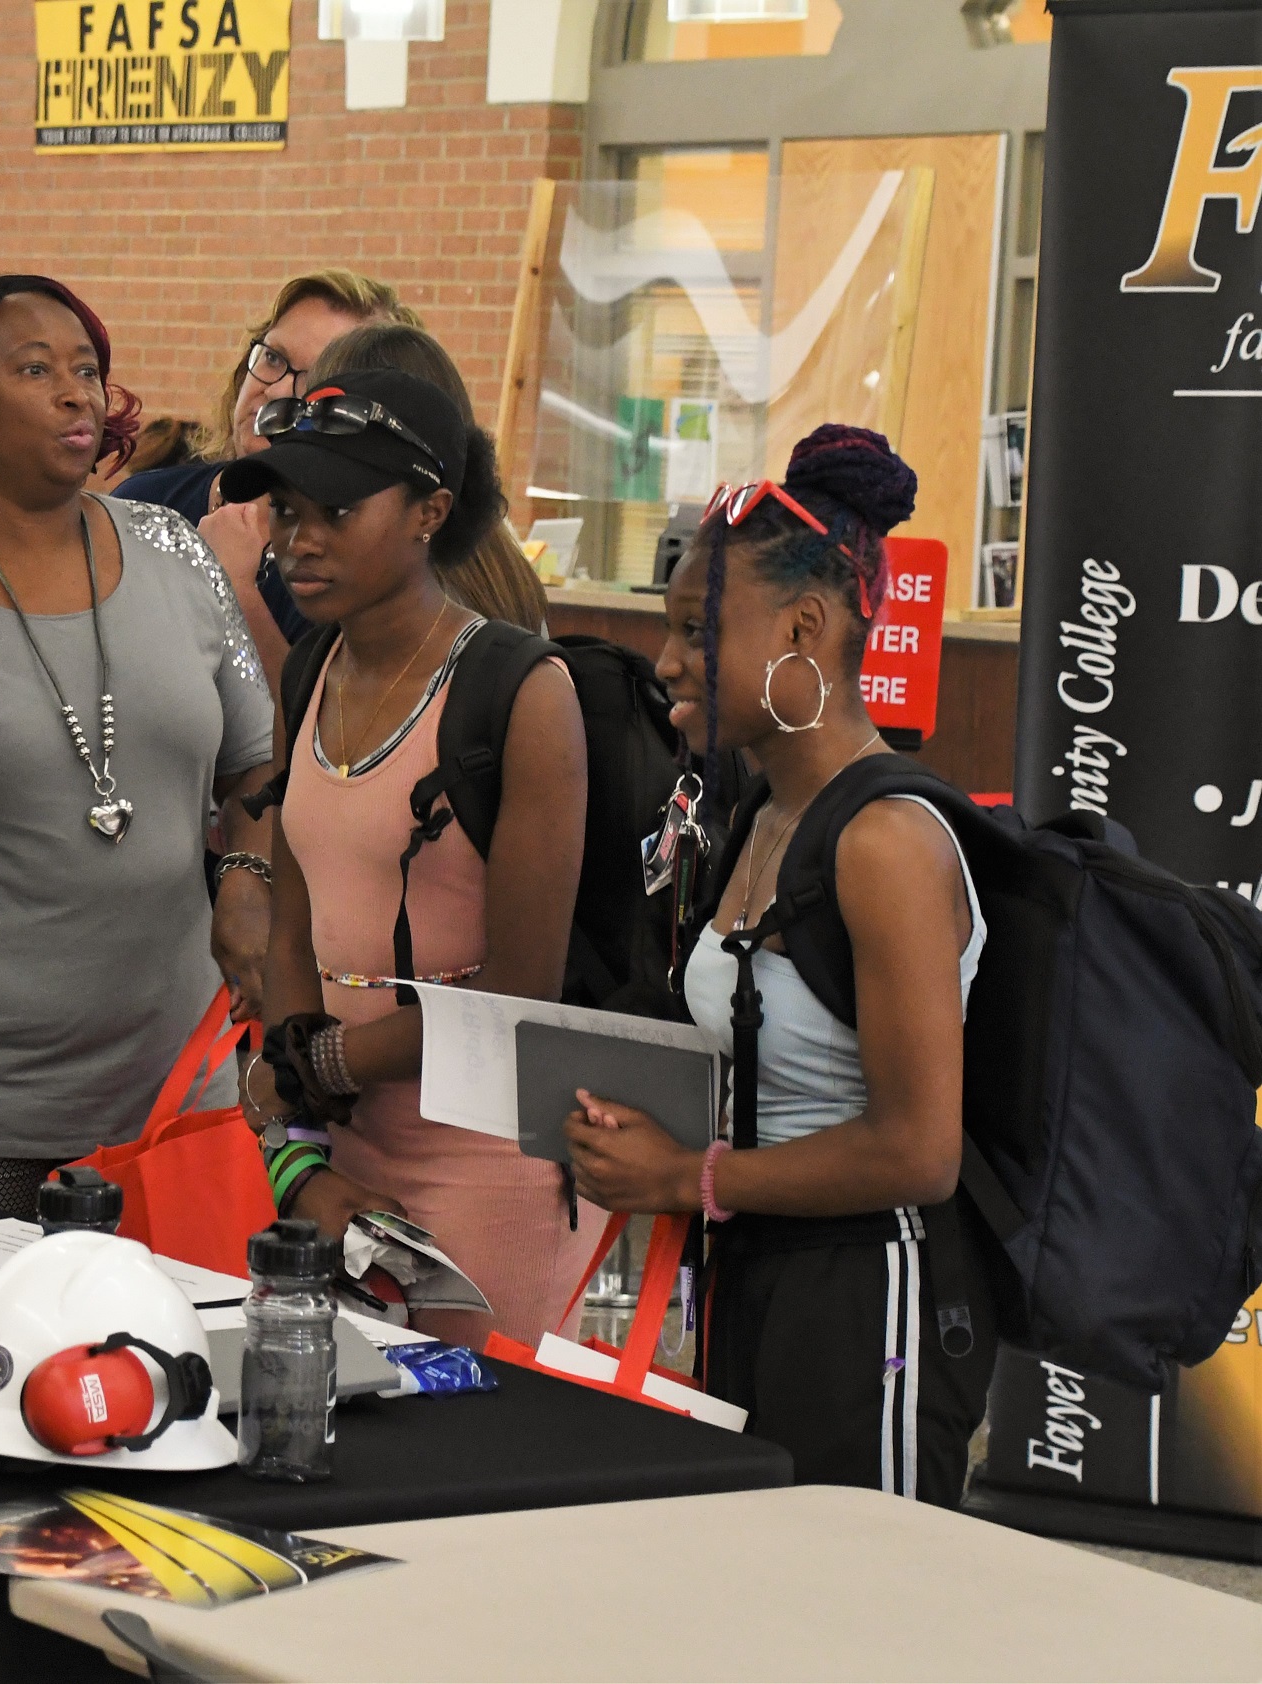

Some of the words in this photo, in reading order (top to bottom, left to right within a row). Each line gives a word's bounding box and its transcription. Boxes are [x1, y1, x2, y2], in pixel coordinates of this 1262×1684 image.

[79, 0, 242, 52] FAFSA
[38, 50, 290, 121] FRENZY
[1057, 557, 1136, 714] College
[87, 1377, 106, 1420] MSA
